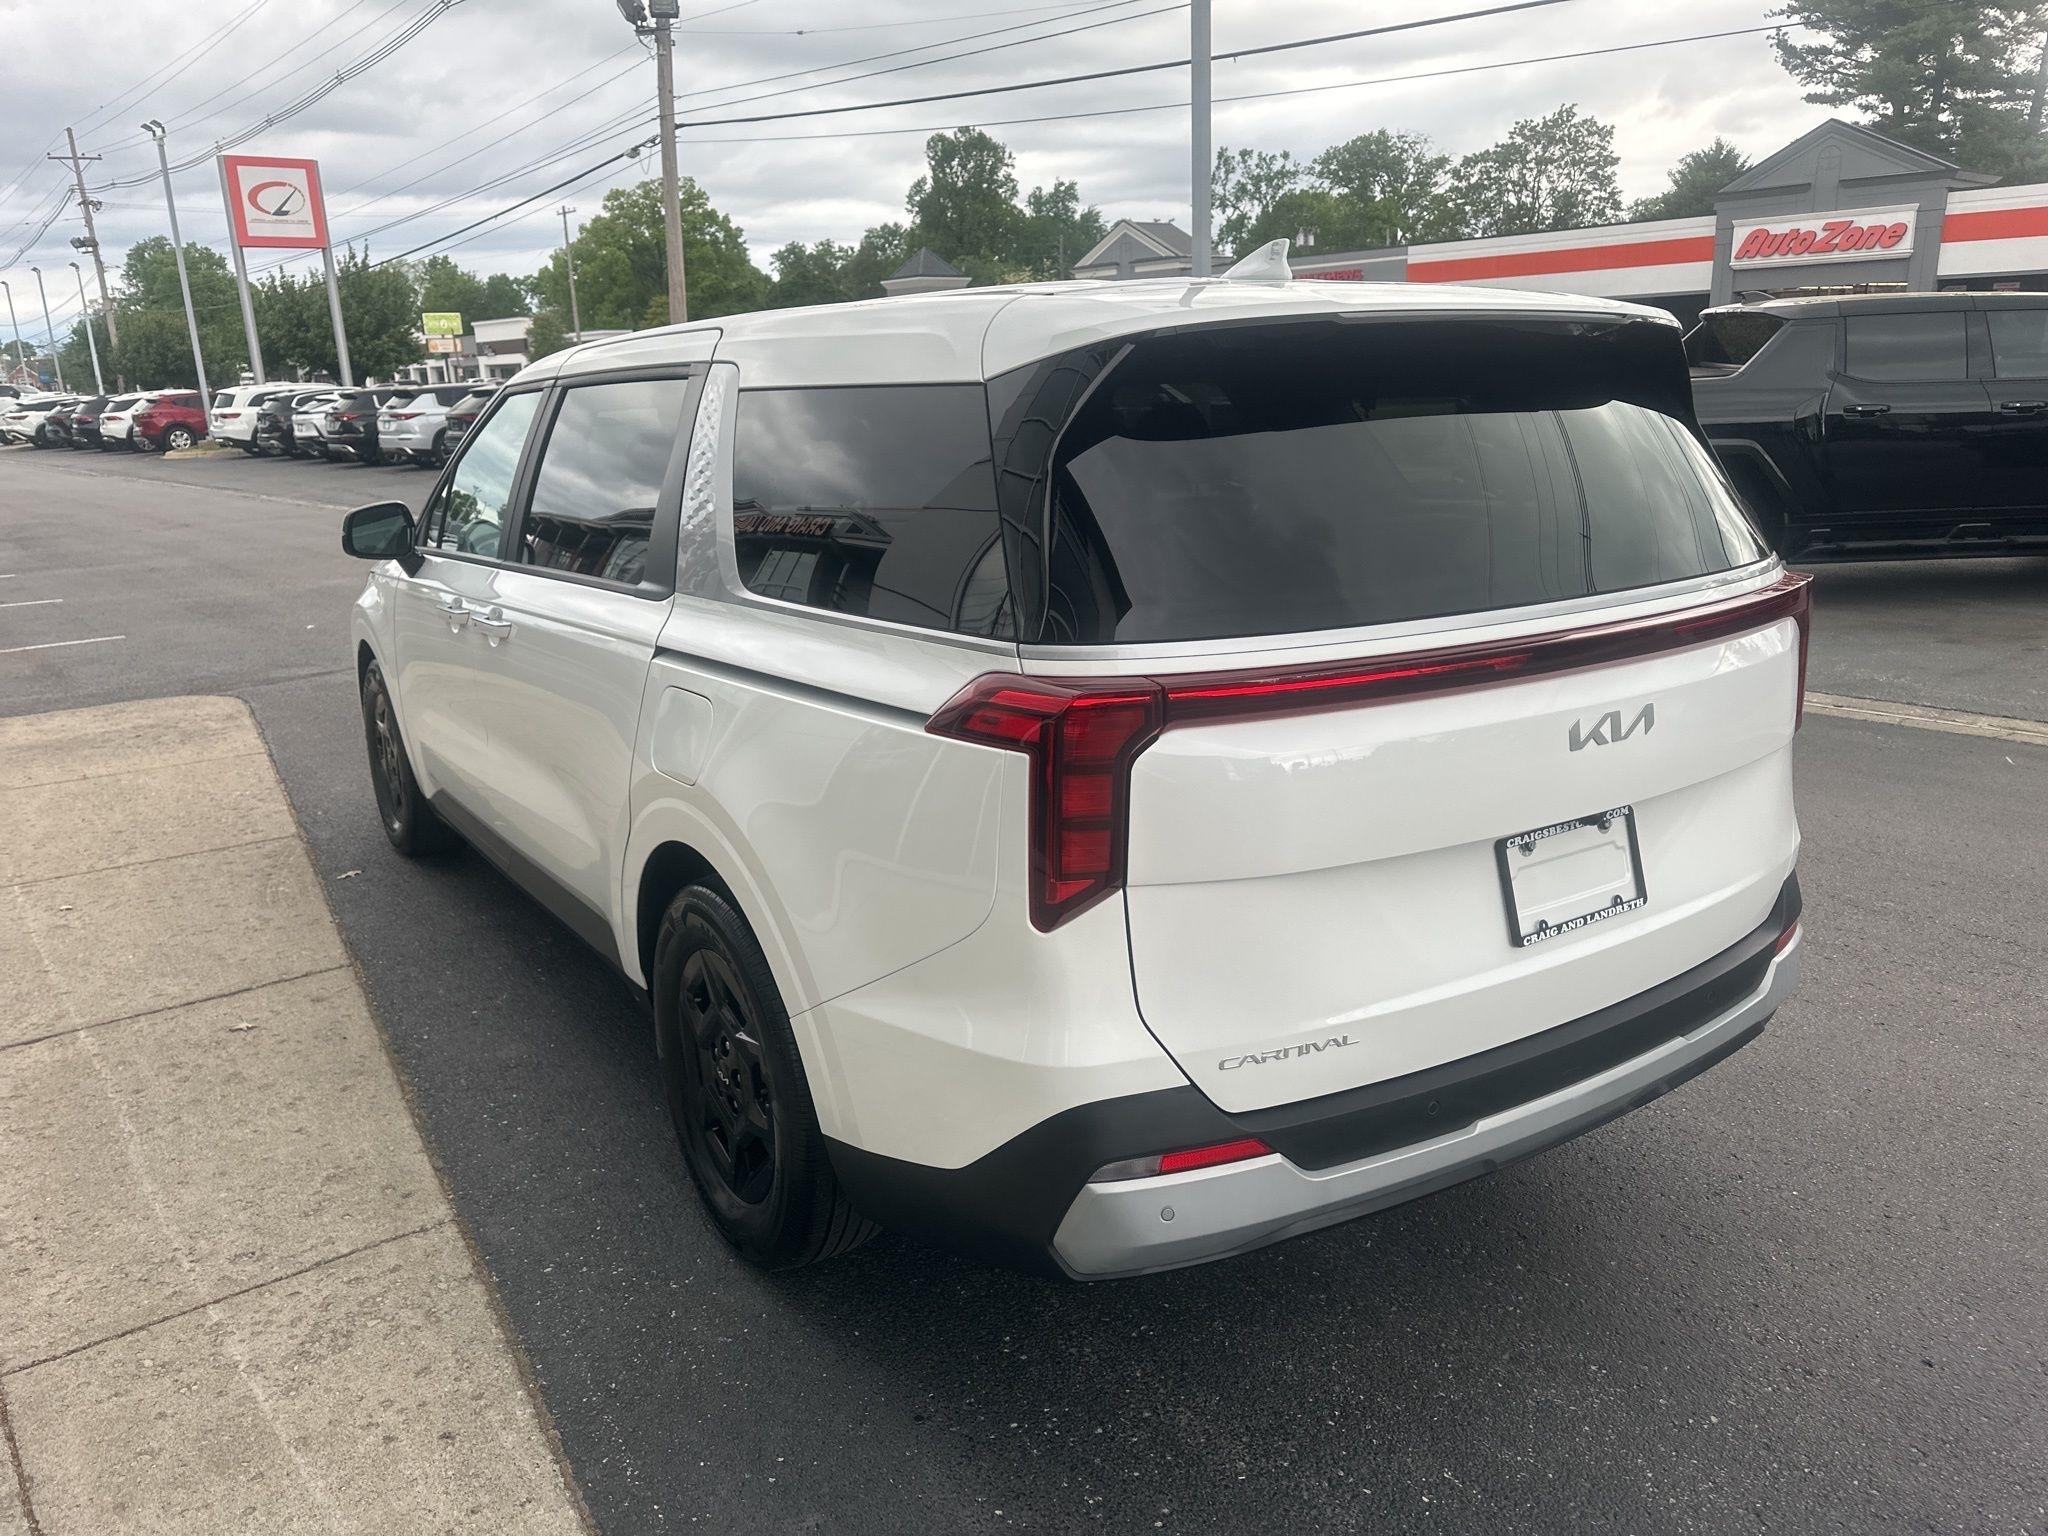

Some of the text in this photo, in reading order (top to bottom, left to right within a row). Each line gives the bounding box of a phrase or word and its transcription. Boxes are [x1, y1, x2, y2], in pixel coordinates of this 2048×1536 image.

[1734, 220, 1908, 259] AutoZone
[1569, 703, 1655, 752] KIA
[1523, 897, 1644, 946] CRAIG AND LANDRETH
[1218, 1034, 1361, 1071] CARNIVAL
